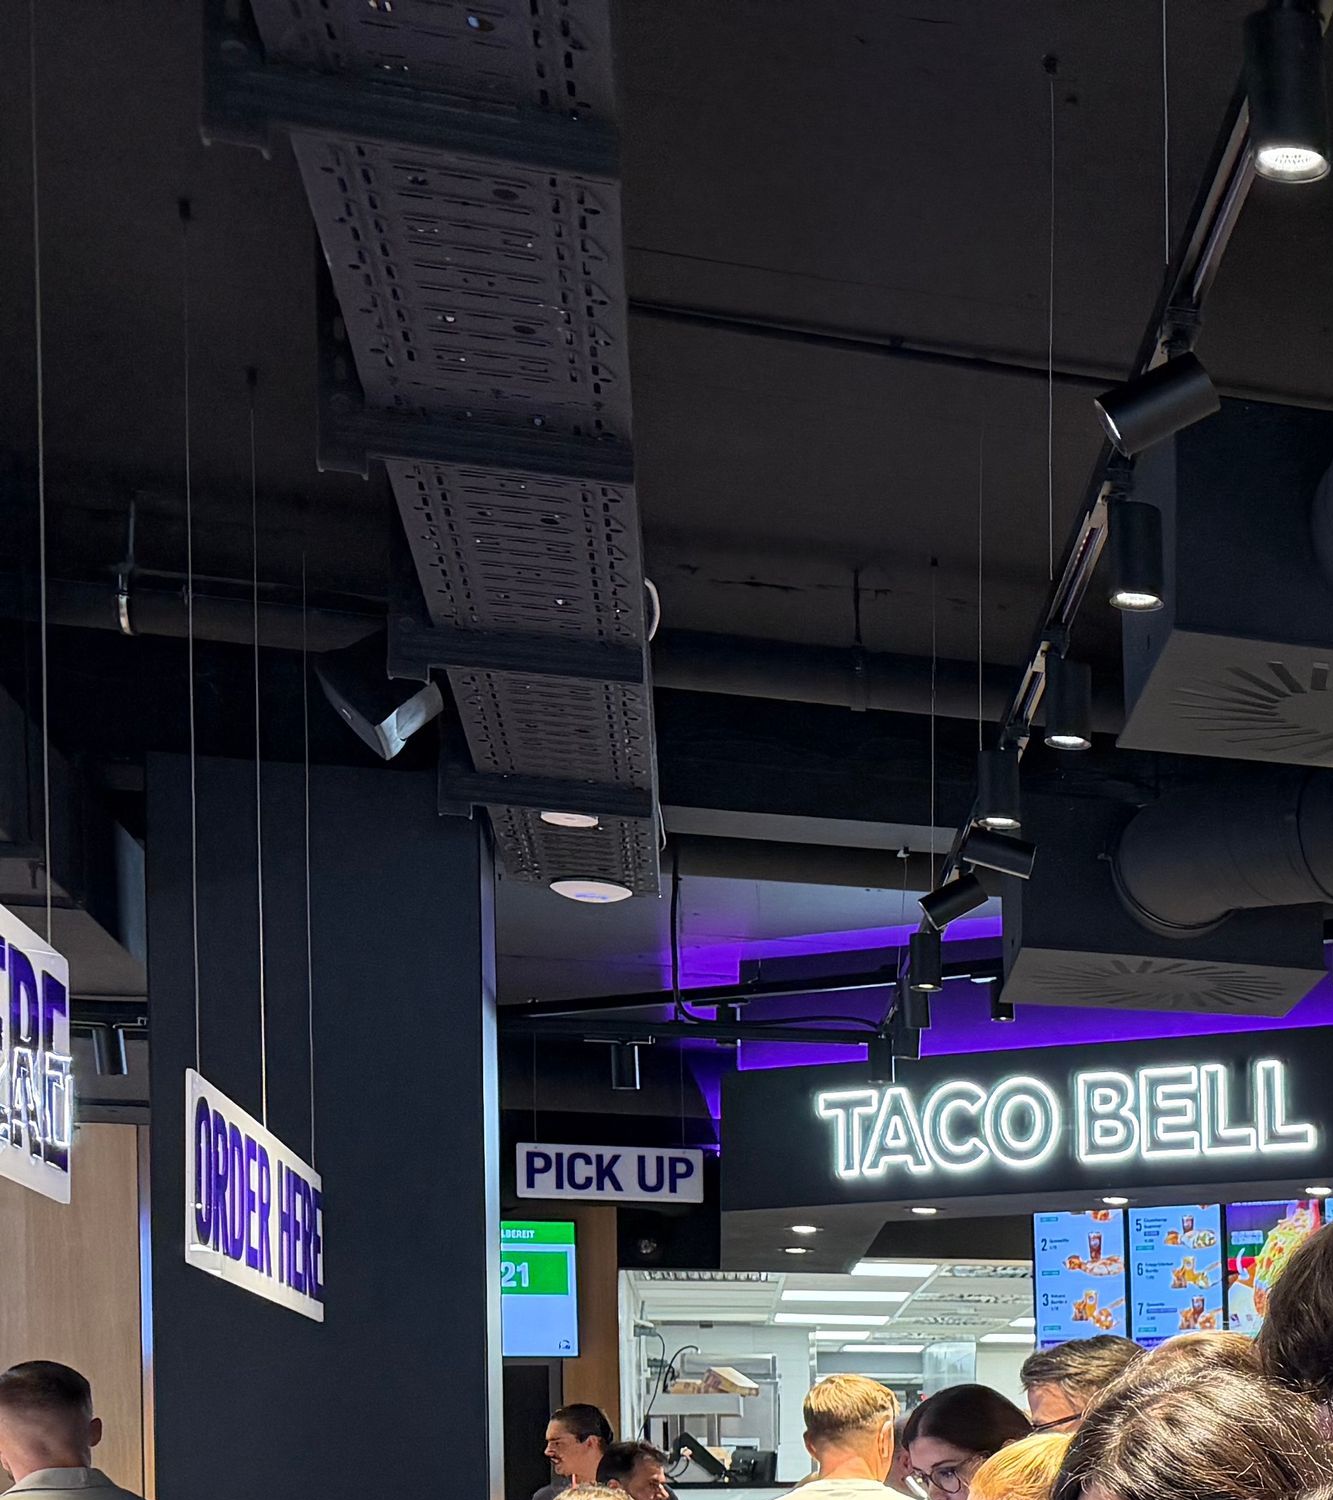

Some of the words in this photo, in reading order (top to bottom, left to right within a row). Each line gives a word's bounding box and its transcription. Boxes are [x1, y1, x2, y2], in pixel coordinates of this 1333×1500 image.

[816, 1074, 1062, 1179] TACO
[1074, 1057, 1318, 1163] BELL
[194, 1096, 272, 1278] ORDER
[277, 1159, 324, 1300] HERE
[526, 1151, 624, 1192] PICK
[637, 1154, 695, 1194] UP
[1041, 1238, 1048, 1252] 2
